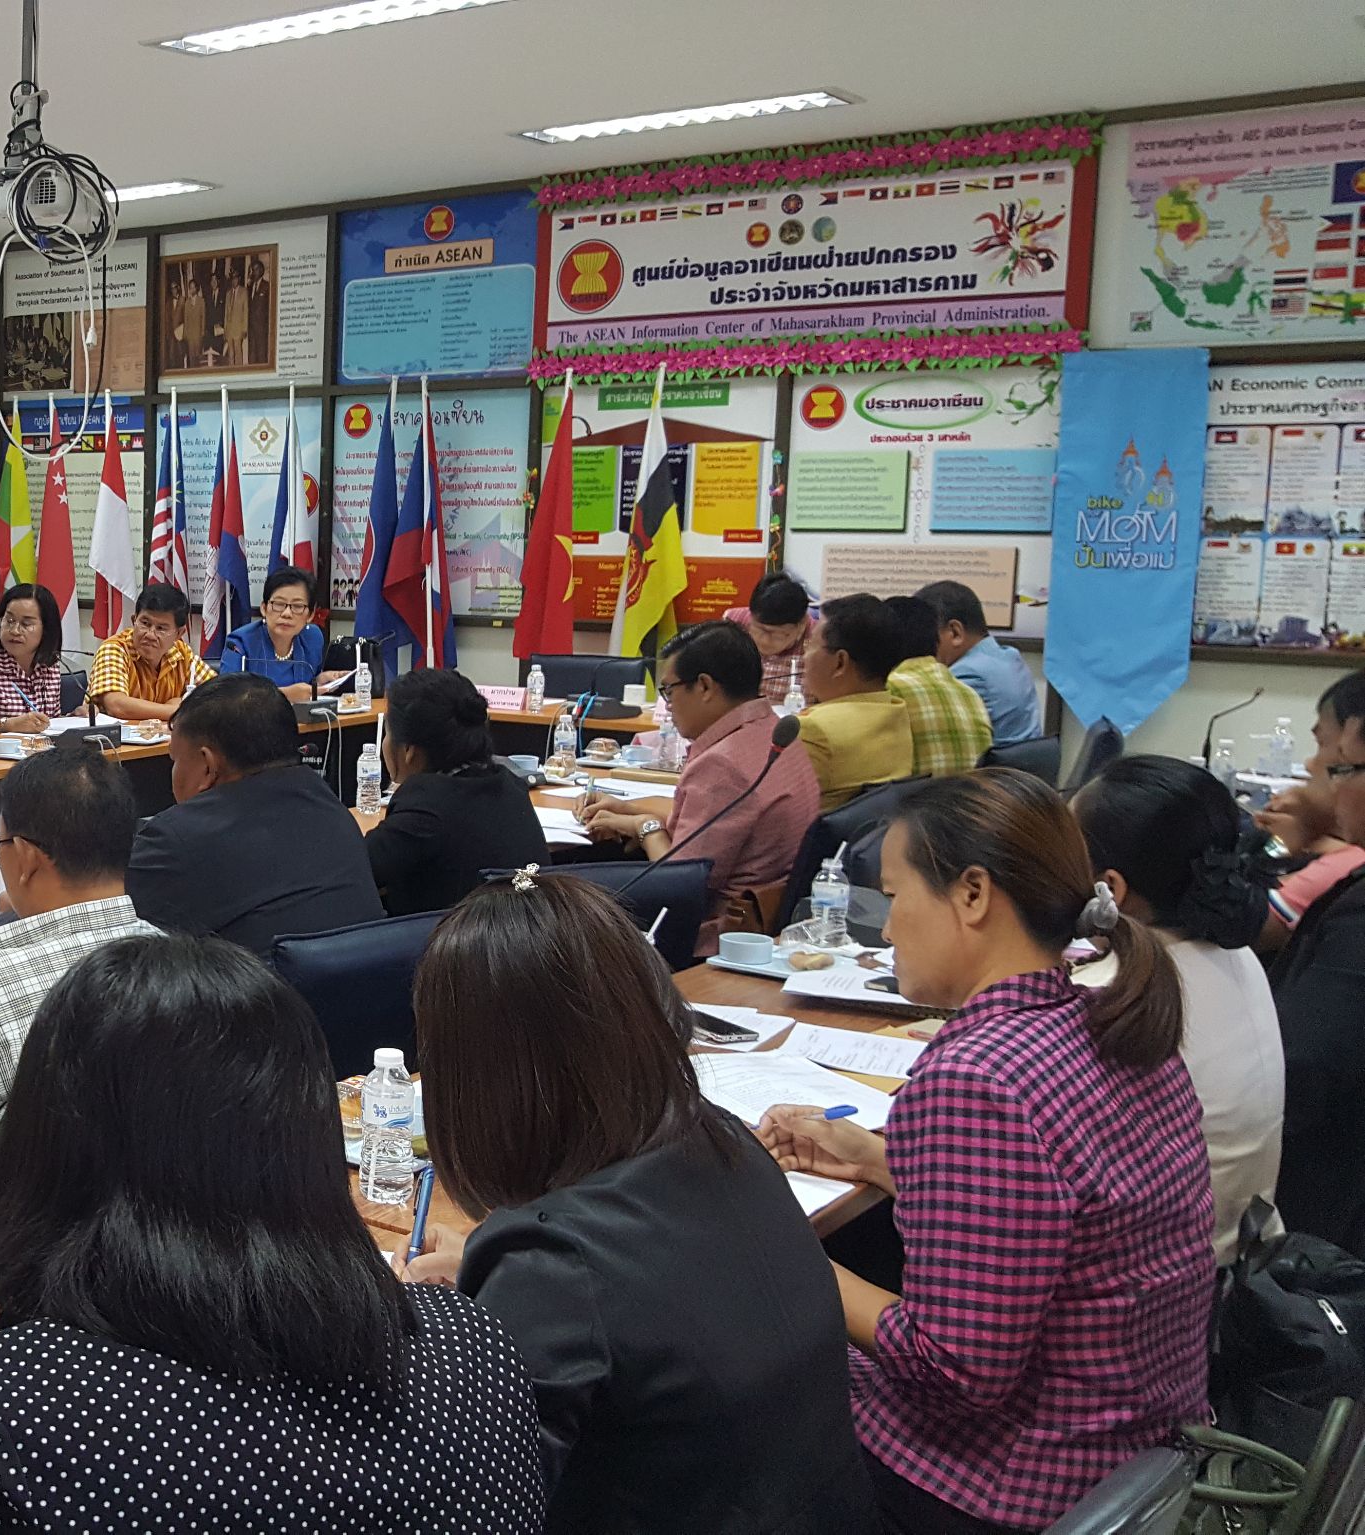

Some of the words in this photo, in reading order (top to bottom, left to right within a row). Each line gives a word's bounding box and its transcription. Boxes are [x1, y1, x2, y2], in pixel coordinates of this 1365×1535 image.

[435, 246, 482, 263] ASEAN
[709, 273, 978, 305] ประจำจังหวัดมหาสารคาม
[558, 331, 578, 343] The
[584, 327, 626, 342] ASEAN
[632, 323, 699, 339] Information
[705, 319, 744, 335] Center
[751, 318, 765, 332] of
[770, 314, 865, 331] Mahasarakham
[872, 309, 936, 326] Provincial
[943, 305, 1050, 322] Administration.
[1231, 377, 1309, 391] Economic
[865, 393, 984, 410] ประชาคมอาเซียน
[927, 434, 934, 442] 3
[1087, 496, 1123, 509] bike
